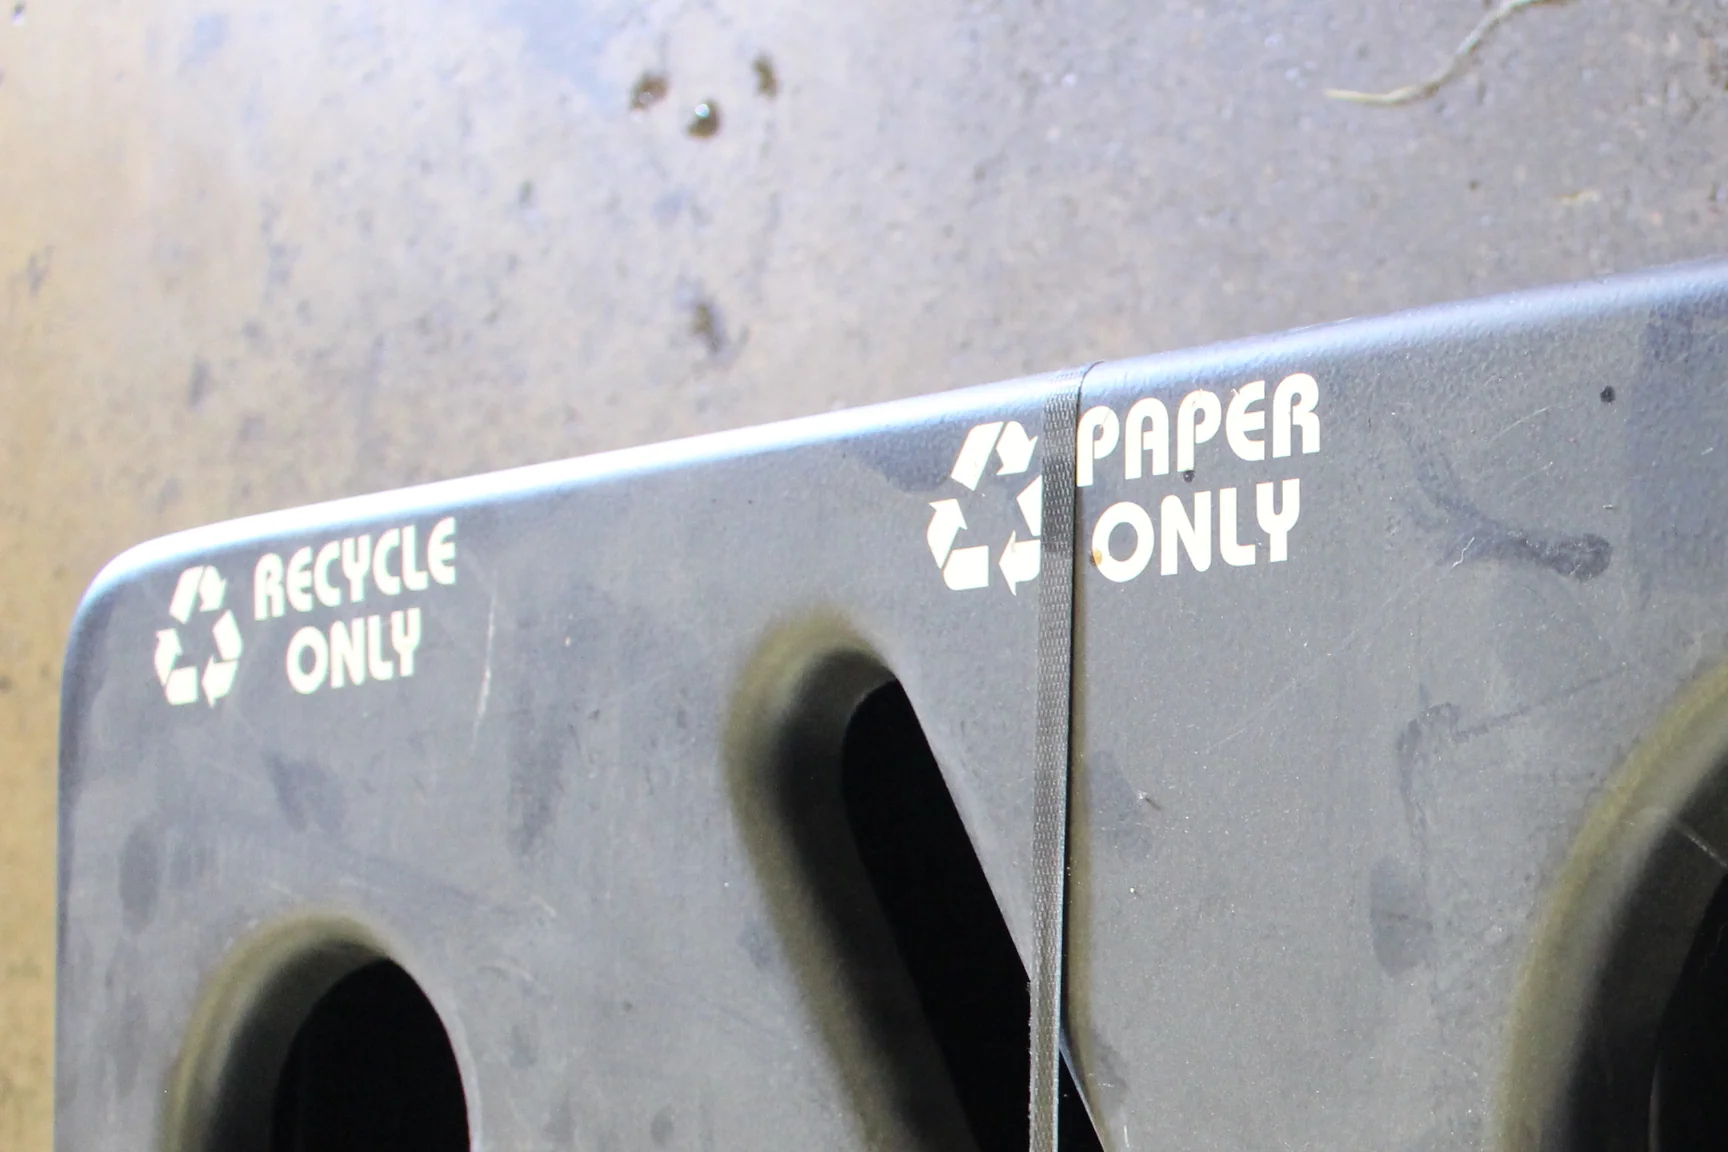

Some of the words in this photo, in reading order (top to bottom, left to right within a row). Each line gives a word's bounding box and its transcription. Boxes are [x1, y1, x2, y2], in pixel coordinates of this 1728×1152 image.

[1076, 373, 1320, 487] PAPER
[254, 516, 456, 621] RECYCLE
[1092, 478, 1300, 583] ONLY
[286, 607, 421, 694] ONLY
